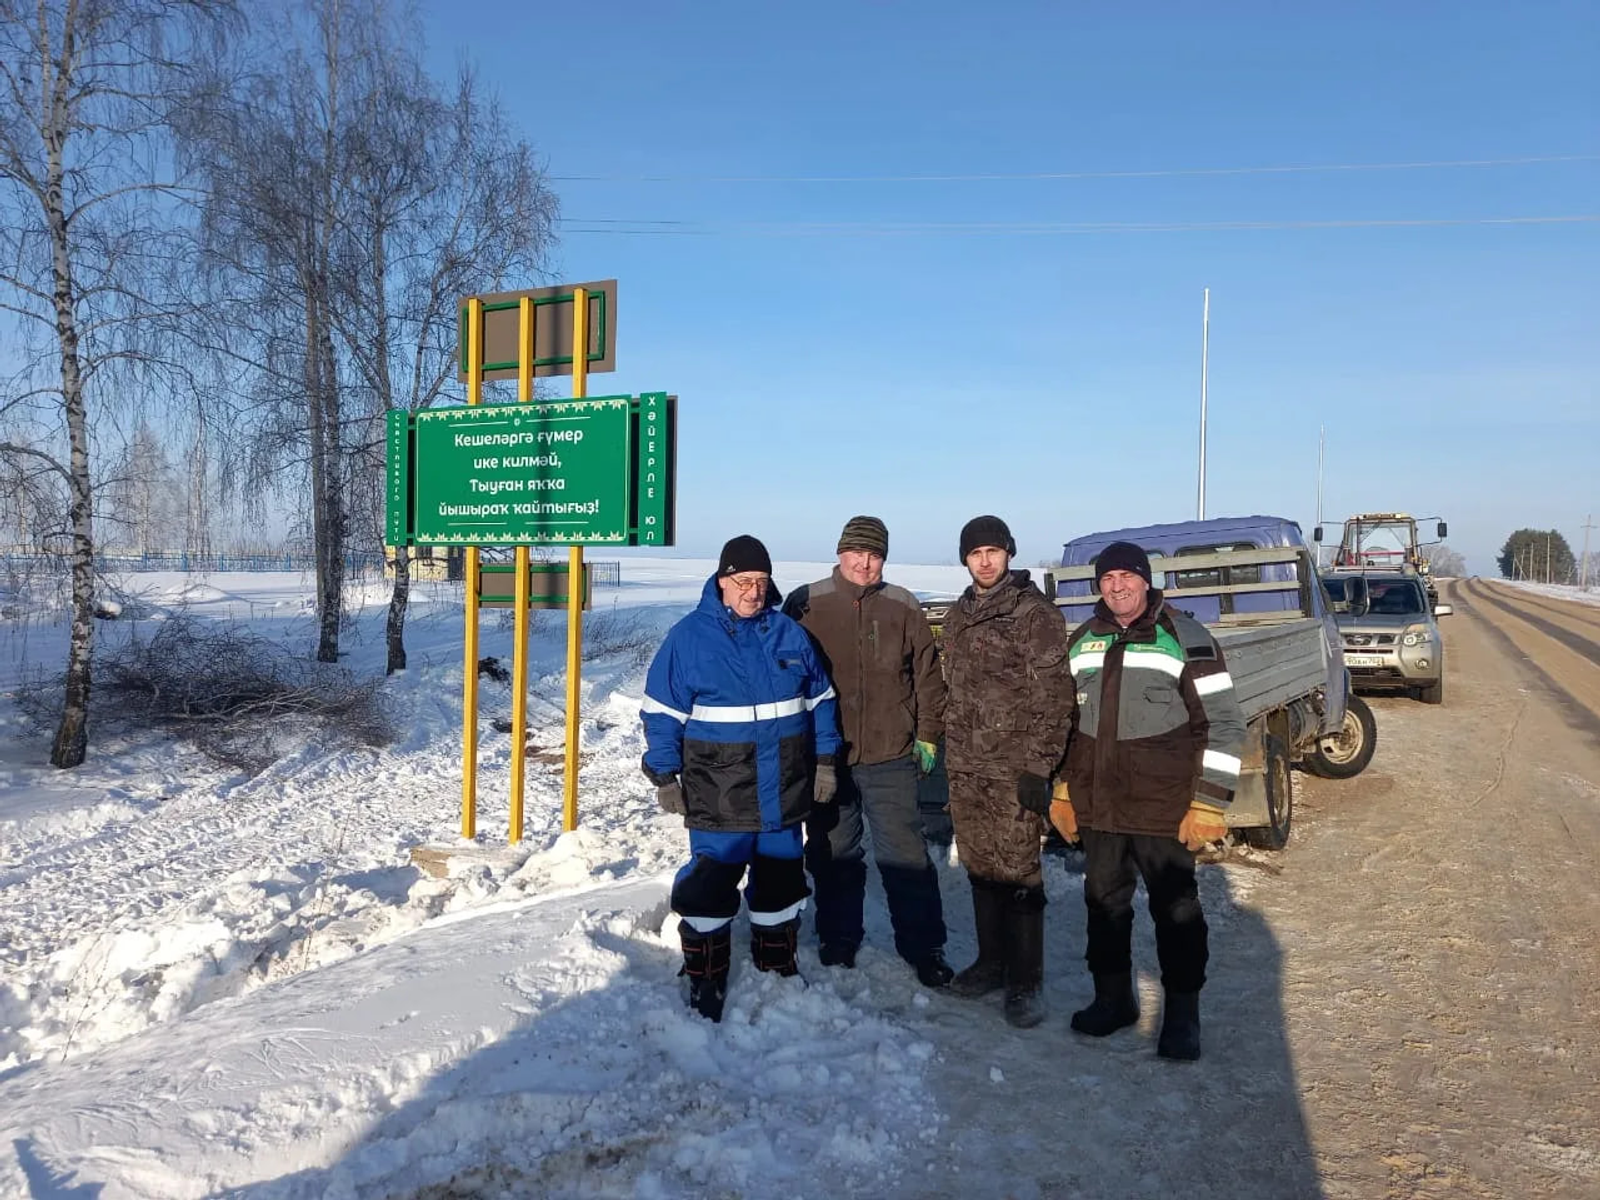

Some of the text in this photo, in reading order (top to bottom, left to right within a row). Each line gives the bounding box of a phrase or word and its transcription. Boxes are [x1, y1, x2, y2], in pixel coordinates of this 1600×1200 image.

[454, 429, 584, 448] Кешеләргә ғүмер
[473, 451, 562, 469] ике килмәй,
[469, 479, 524, 495] Тыуған
[645, 515, 656, 541] ЮЛ
